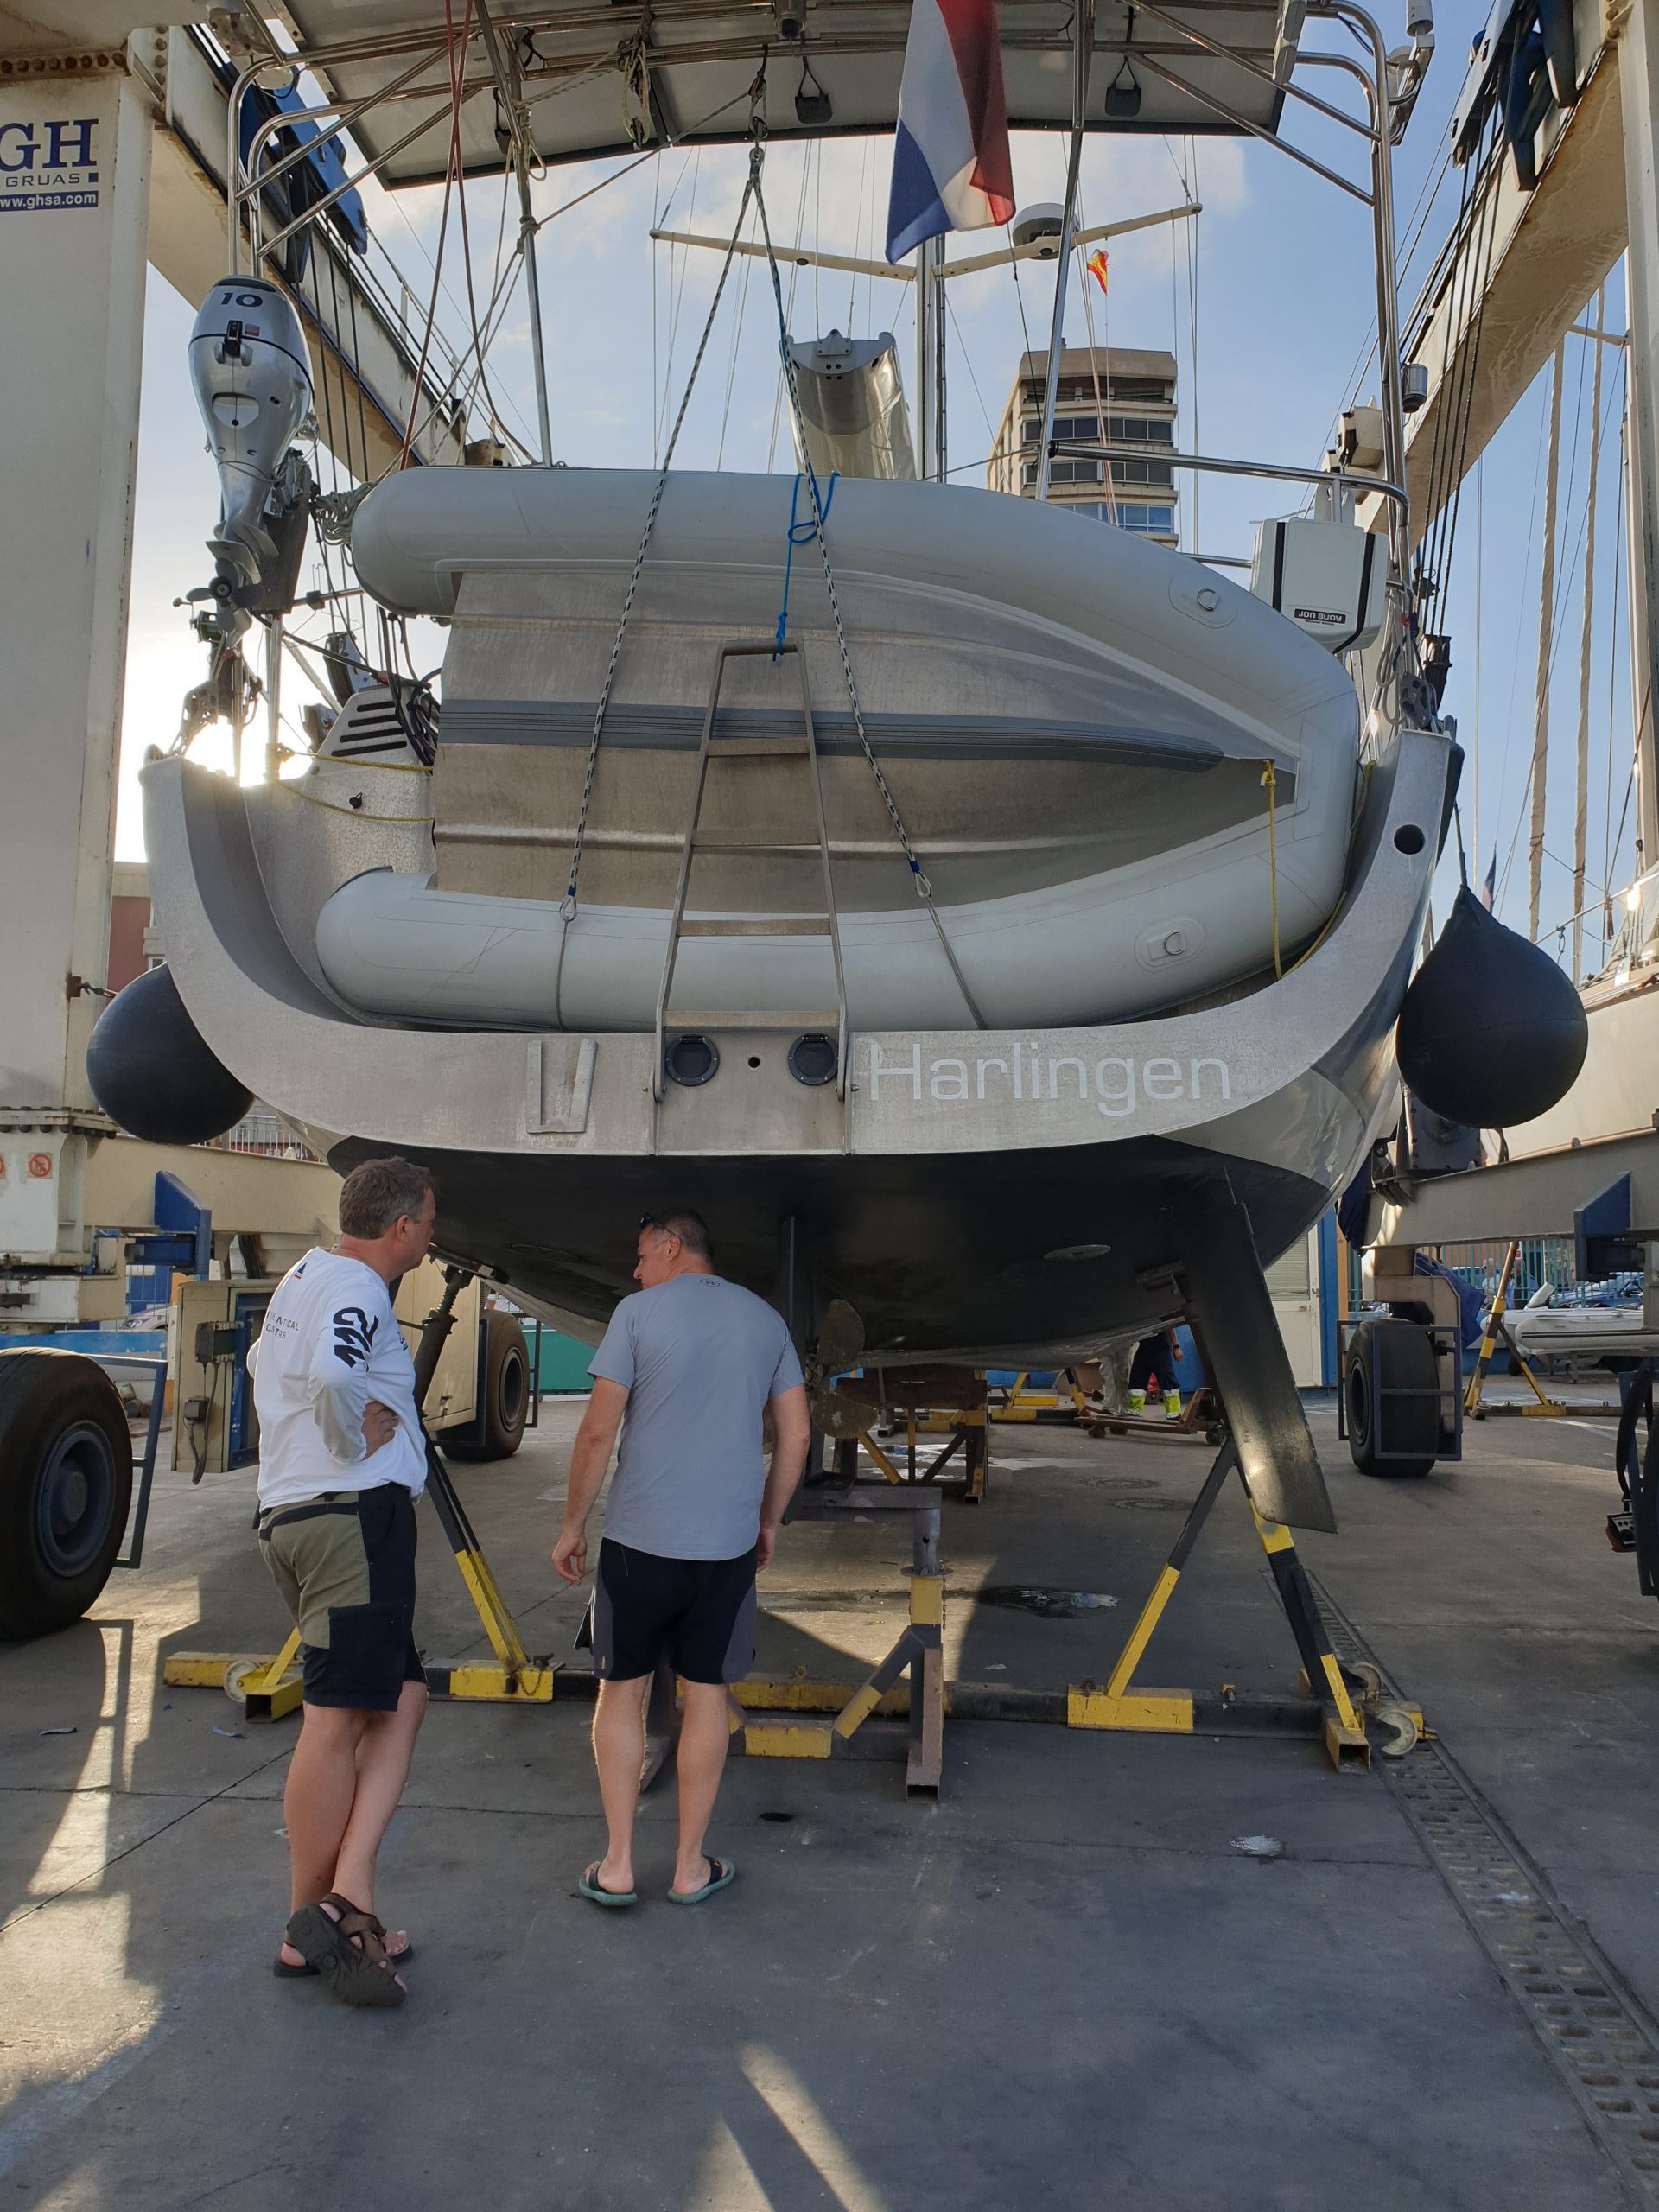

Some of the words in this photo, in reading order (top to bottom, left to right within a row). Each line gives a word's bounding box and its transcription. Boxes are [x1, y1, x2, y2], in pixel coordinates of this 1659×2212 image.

[0, 119, 99, 171] GH
[6, 173, 80, 188] GRUAS
[0, 194, 97, 209] ww.ghsa.com
[220, 292, 263, 307] 10
[870, 1042, 1230, 1116] Harlingen
